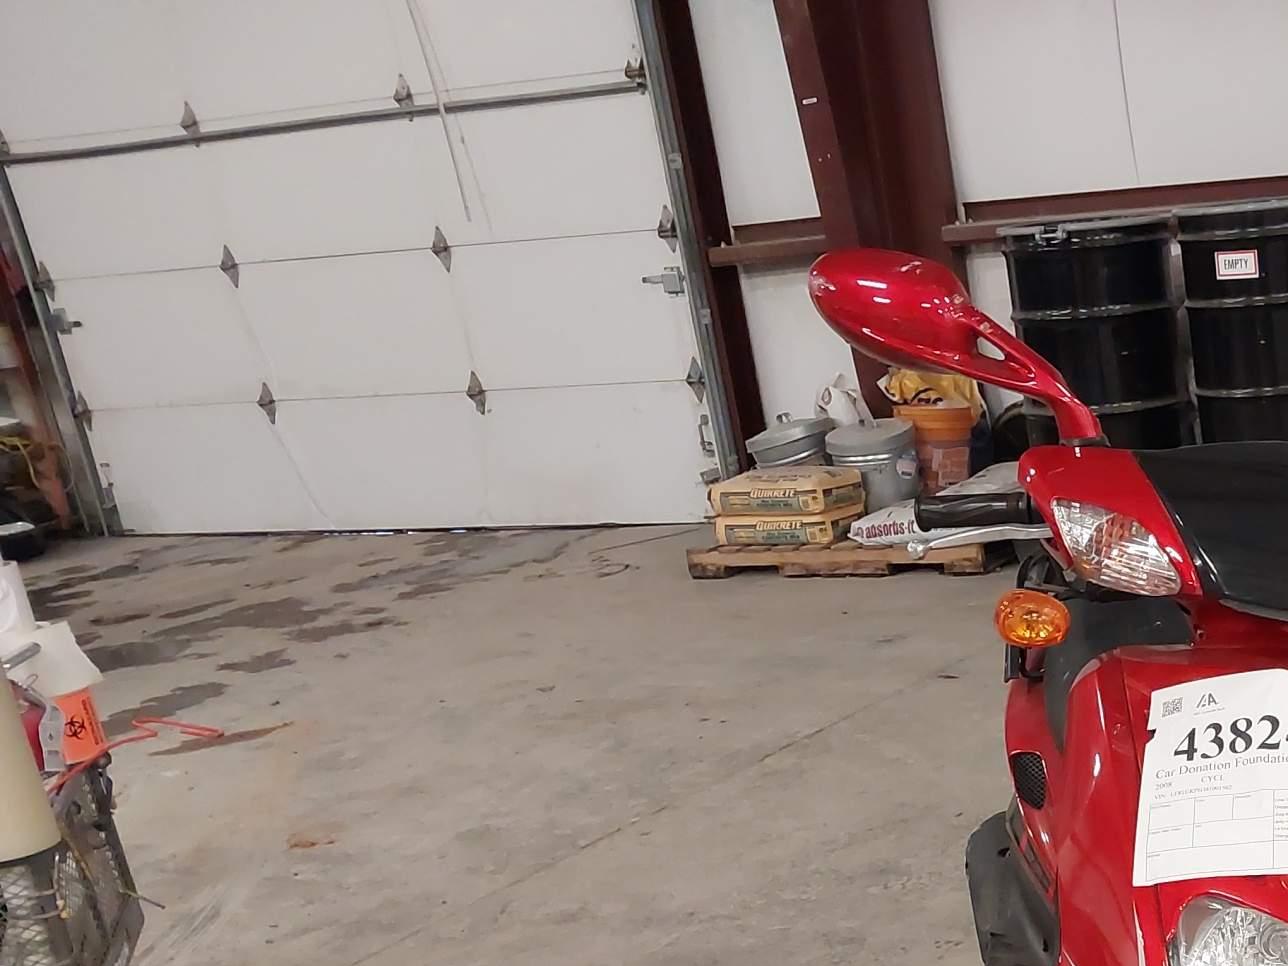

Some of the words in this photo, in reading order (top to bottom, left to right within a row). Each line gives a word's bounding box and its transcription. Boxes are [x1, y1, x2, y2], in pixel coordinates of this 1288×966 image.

[1223, 258, 1249, 271] EMPTY
[750, 488, 796, 498] QUIKRETE
[756, 521, 802, 531] QUIKRETE
[1155, 768, 1176, 780] Car
[1179, 761, 1231, 775] Donation
